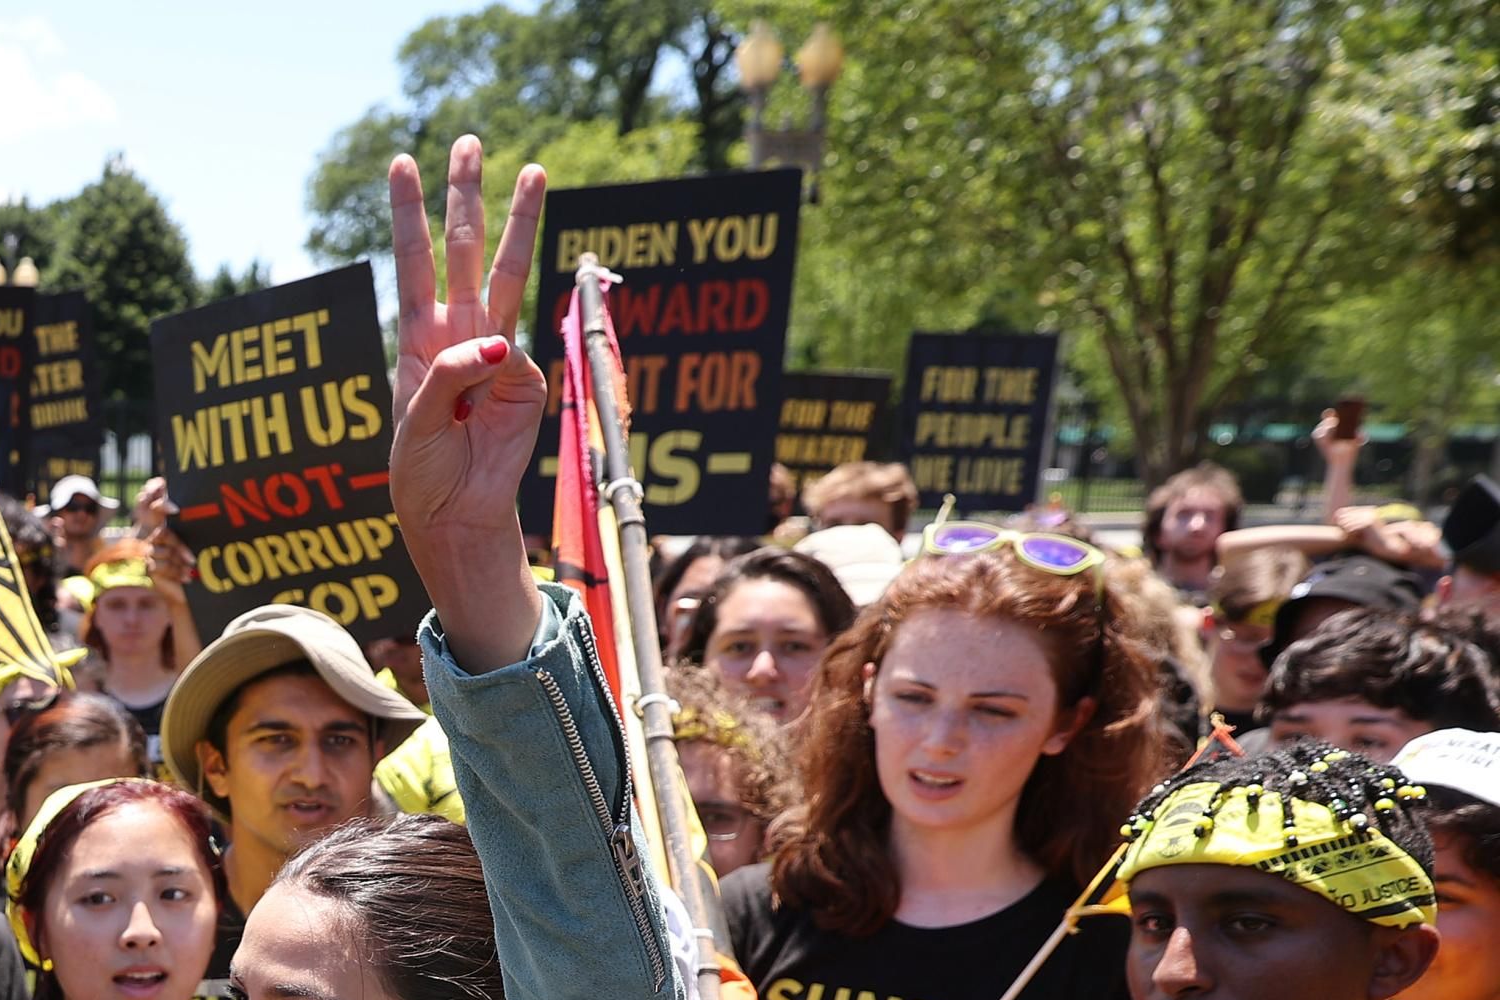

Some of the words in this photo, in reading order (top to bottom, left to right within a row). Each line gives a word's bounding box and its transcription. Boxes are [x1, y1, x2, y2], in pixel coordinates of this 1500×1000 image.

[556, 221, 679, 273] BIDEN
[686, 212, 781, 263] YOU
[34, 320, 80, 356] THE
[190, 308, 330, 393] MEET
[30, 358, 85, 397] TER
[674, 350, 761, 413] FOR
[920, 365, 979, 402] FOR
[983, 366, 1040, 404] THE
[171, 391, 294, 473] WITH
[299, 373, 383, 448] US
[913, 411, 1032, 450] PEOPLE
[197, 512, 401, 594] CORRUP
[272, 573, 399, 627] OP
